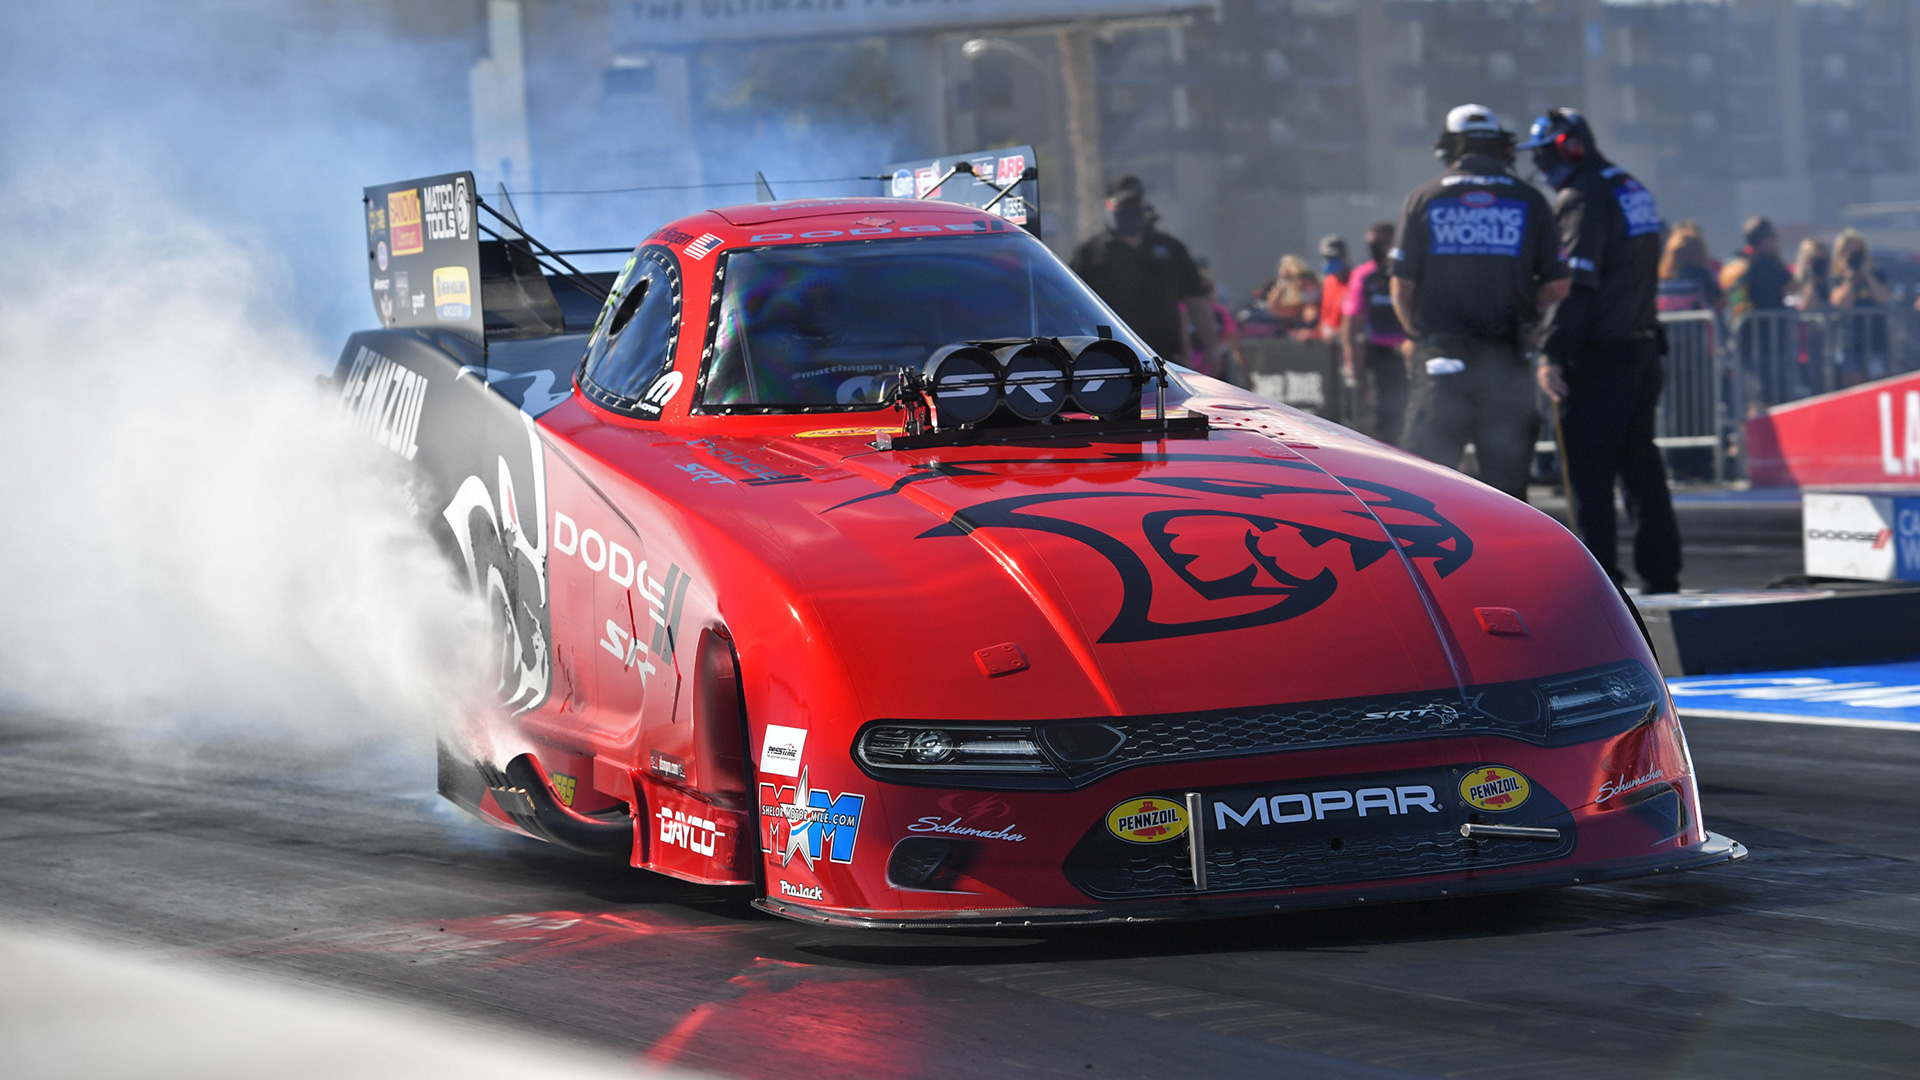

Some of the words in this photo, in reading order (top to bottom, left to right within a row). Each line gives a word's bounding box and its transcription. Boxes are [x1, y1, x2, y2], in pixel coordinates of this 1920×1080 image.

[423, 183, 454, 213] MATCO
[425, 210, 456, 240] TOOLS
[1430, 206, 1523, 227] CAMPING
[750, 223, 987, 244] DODGE
[1433, 224, 1521, 246] WORLD
[791, 363, 883, 381] @matthagan
[936, 367, 1131, 403] SRT
[335, 345, 428, 461] PENNZOIL
[686, 438, 786, 482] DODGE
[674, 462, 736, 487] SRT
[1807, 528, 1882, 543] DODGE
[553, 511, 666, 628] DODGE
[600, 618, 657, 690] SRT
[1361, 708, 1436, 721] SRT
[1468, 783, 1523, 808] PENNZOIL
[1594, 761, 1664, 804] Schumacher
[809, 812, 856, 828] MILE.COM
[1213, 784, 1440, 831] MOPAR
[655, 806, 726, 858] DAYCO
[907, 815, 1027, 842] Schumacher
[1118, 811, 1182, 832] PENNZOIL
